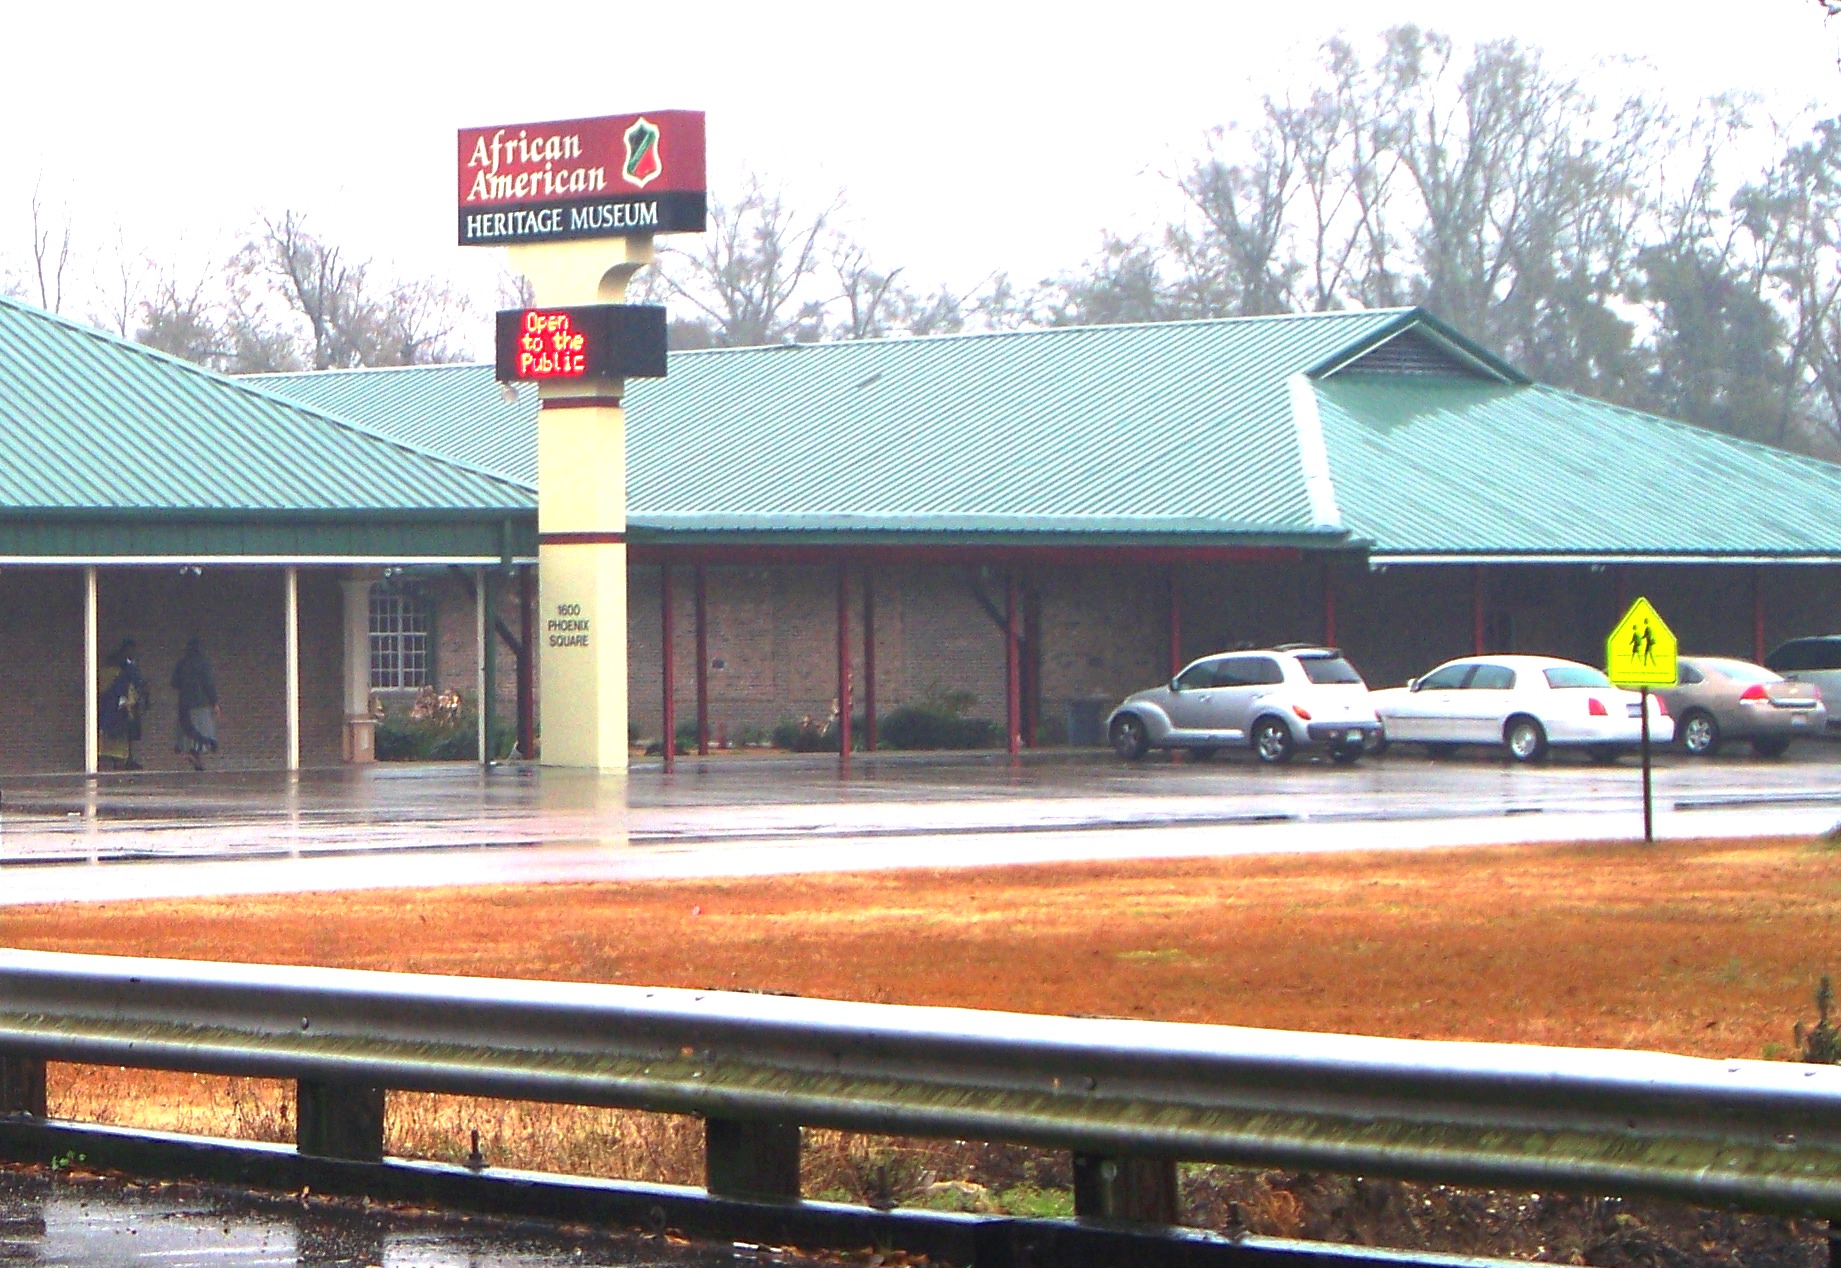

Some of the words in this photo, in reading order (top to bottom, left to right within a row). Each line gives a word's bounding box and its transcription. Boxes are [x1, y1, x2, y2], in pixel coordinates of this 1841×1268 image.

[467, 129, 583, 178] African
[467, 161, 607, 201] American
[467, 208, 564, 238] HERITAGE
[571, 202, 658, 230] MUSEUM
[527, 311, 569, 334] Open
[522, 332, 543, 352] to
[552, 330, 584, 351] the
[521, 351, 585, 373] Public
[557, 604, 581, 616] 1600
[548, 620, 589, 631] PHOENIX
[549, 634, 589, 647] SQUARE
